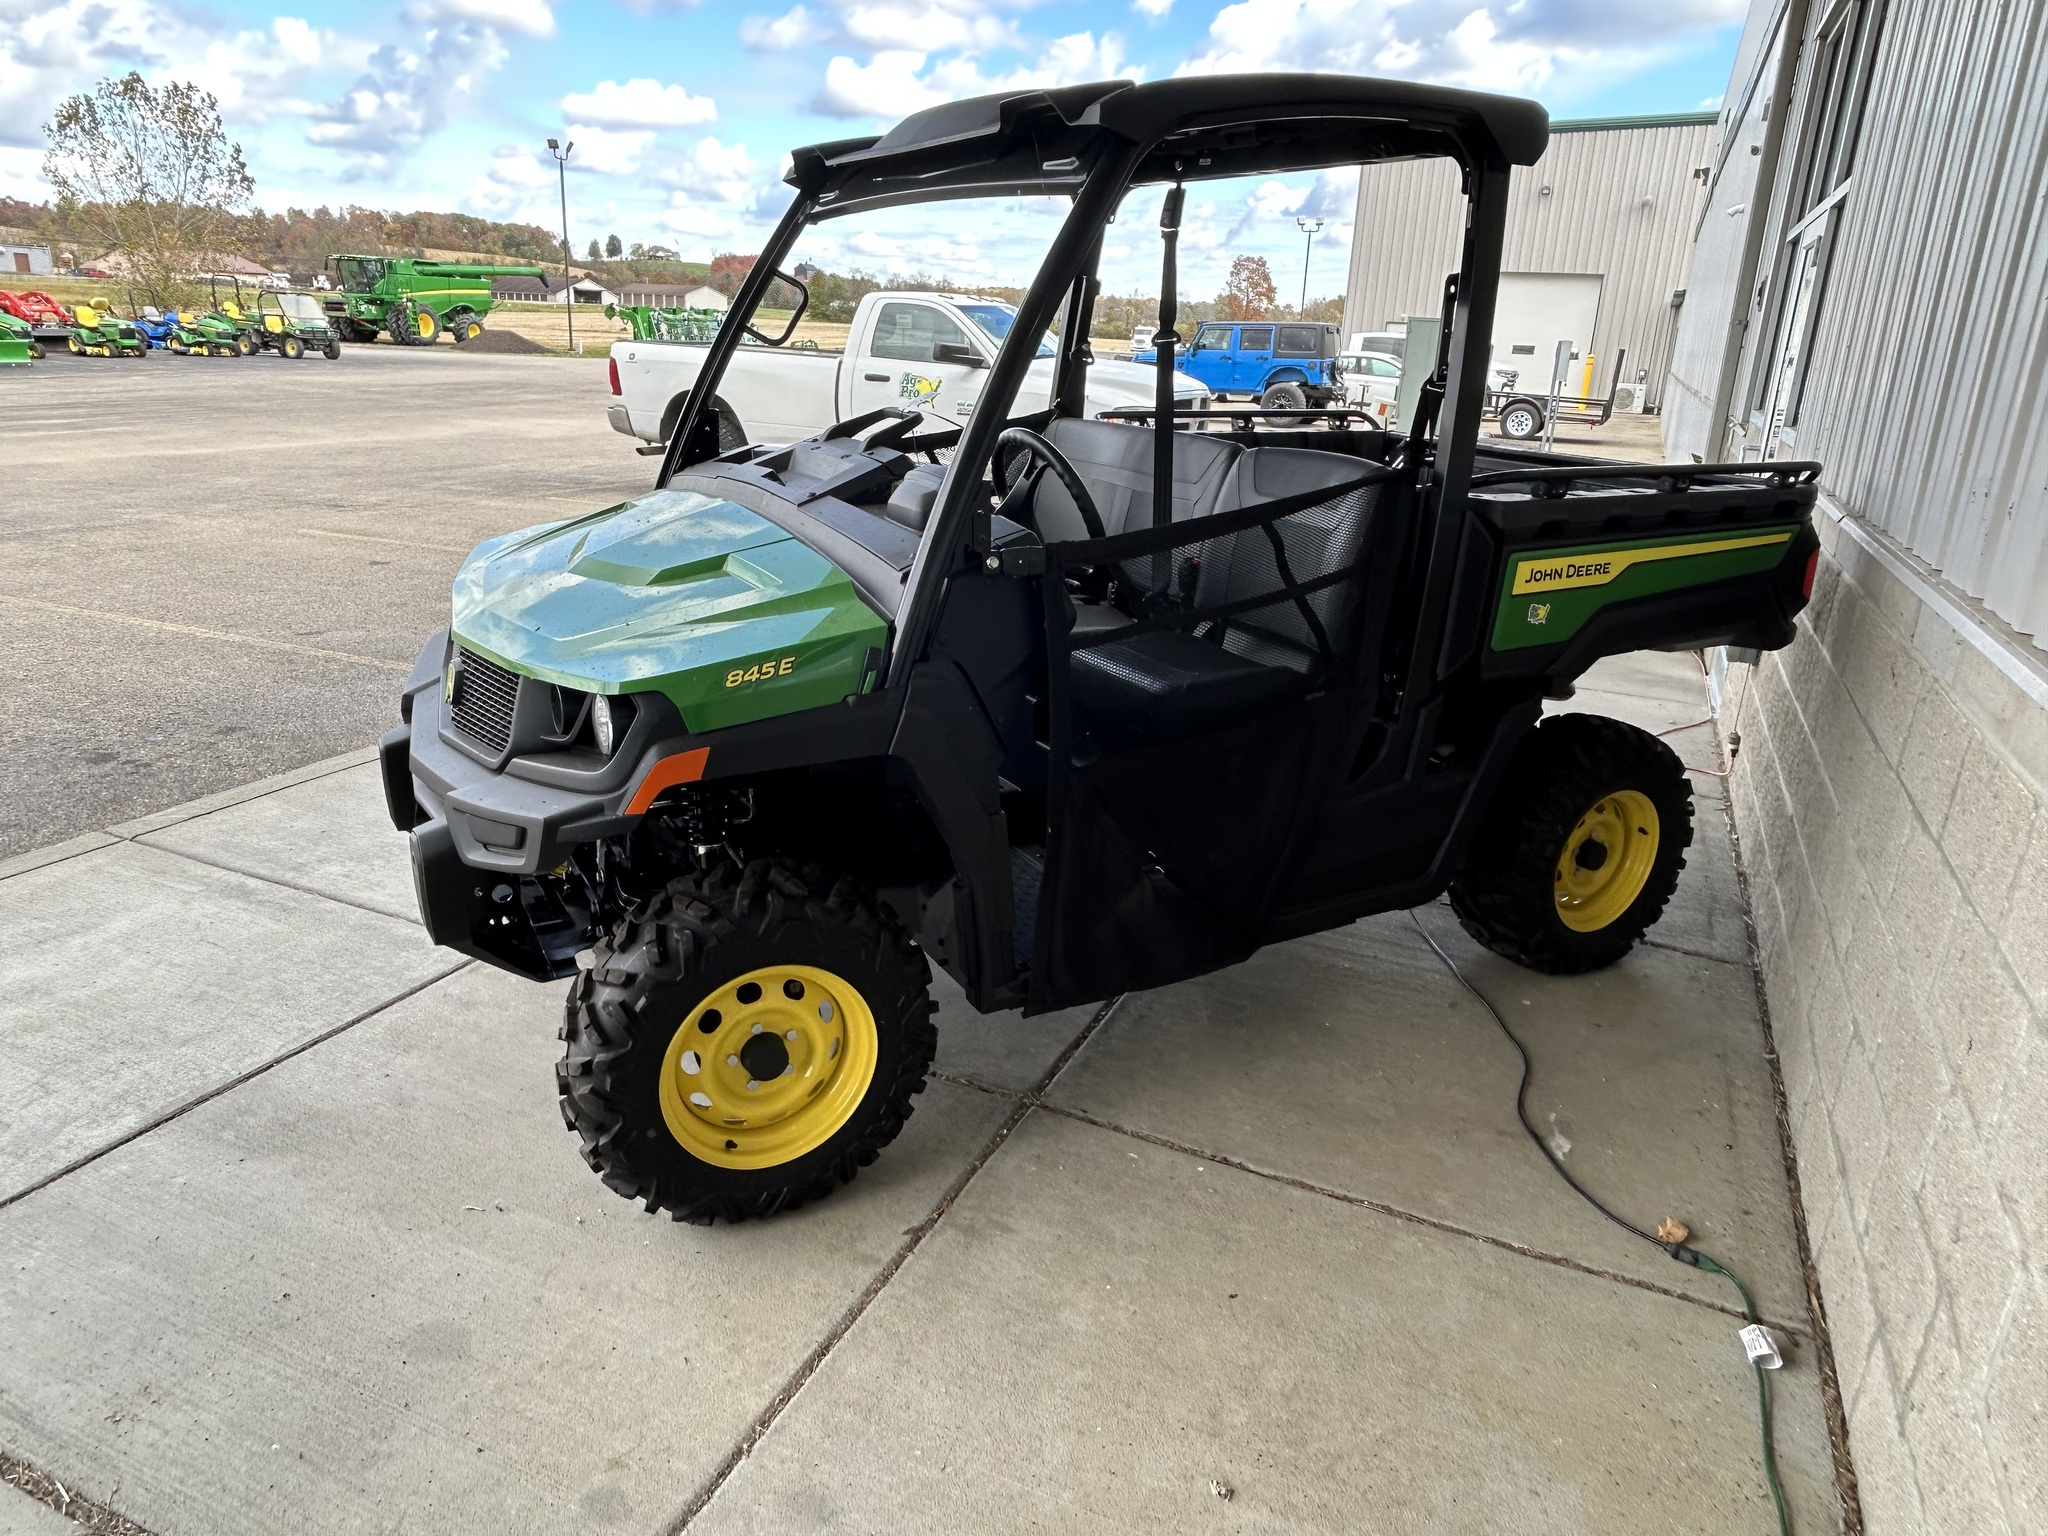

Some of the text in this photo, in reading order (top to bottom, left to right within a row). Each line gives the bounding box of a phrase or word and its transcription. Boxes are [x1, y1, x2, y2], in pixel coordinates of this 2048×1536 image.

[900, 385, 920, 398] Pro
[1524, 562, 1612, 584] JOHN DEERE
